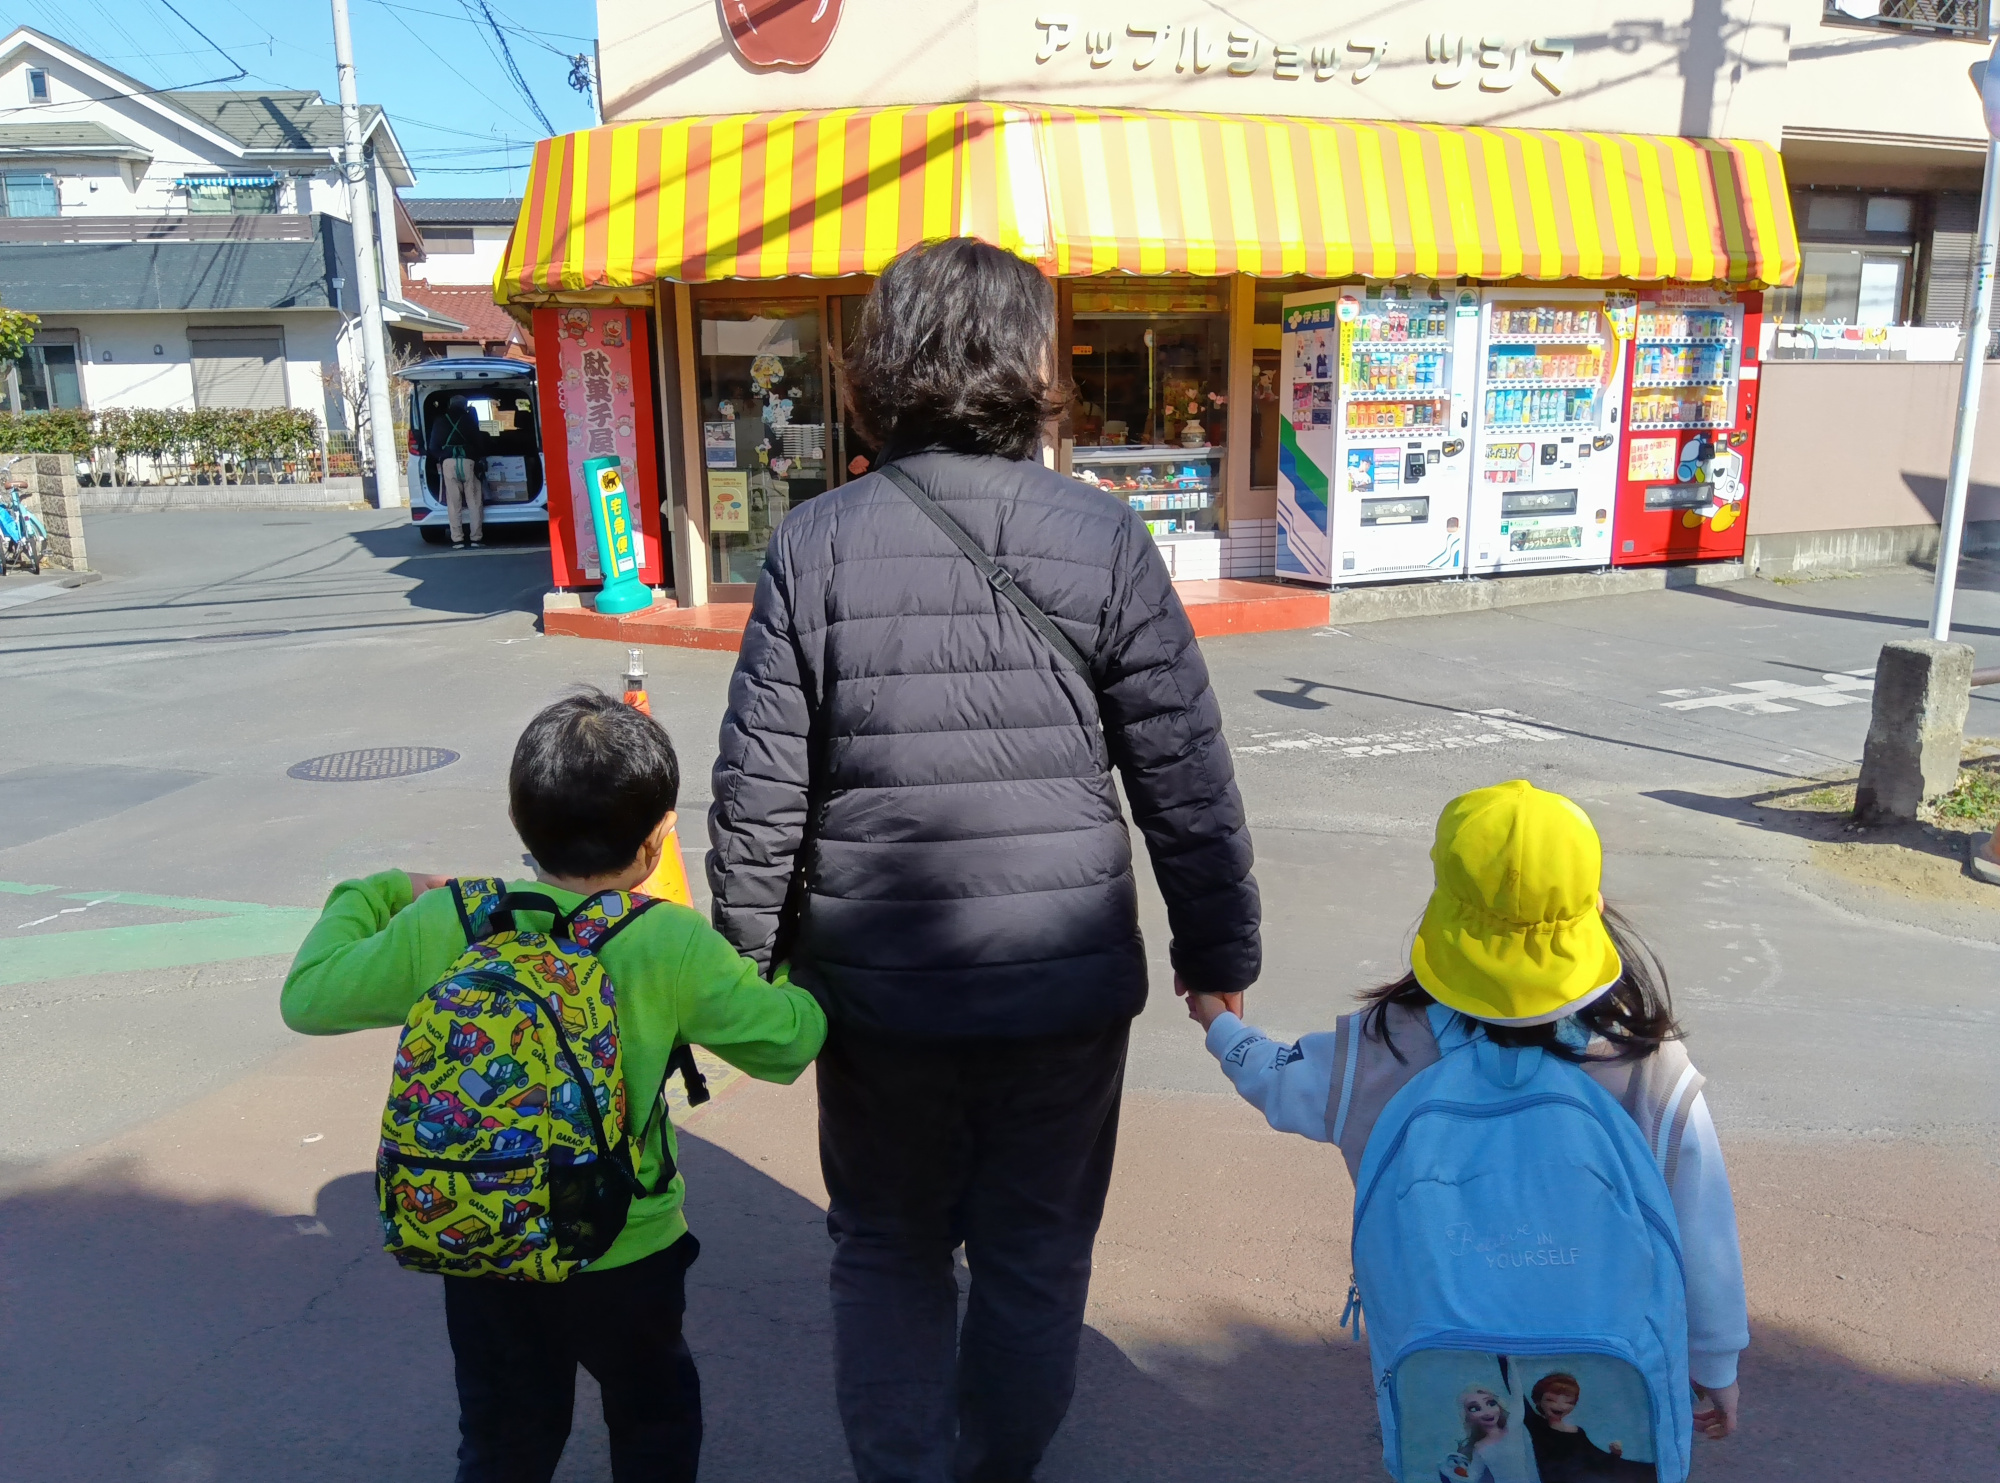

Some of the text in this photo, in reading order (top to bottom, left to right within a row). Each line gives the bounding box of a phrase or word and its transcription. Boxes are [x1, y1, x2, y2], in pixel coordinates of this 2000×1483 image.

[1035, 15, 1389, 85] アップルショップ
[1302, 308, 1330, 324] 伊藤園
[610, 498, 628, 554] 宅急便
[581, 960, 599, 986] GARACH
[586, 996, 599, 1029] GARACH
[431, 1065, 458, 1090] GARACH
[458, 1136, 485, 1160] GARACH
[556, 1132, 585, 1147] GARACH
[468, 1199, 499, 1221] GARACH
[404, 1214, 430, 1241] GARACH
[1537, 1231, 1553, 1246] IN
[1485, 1247, 1580, 1269] YOURSELF
